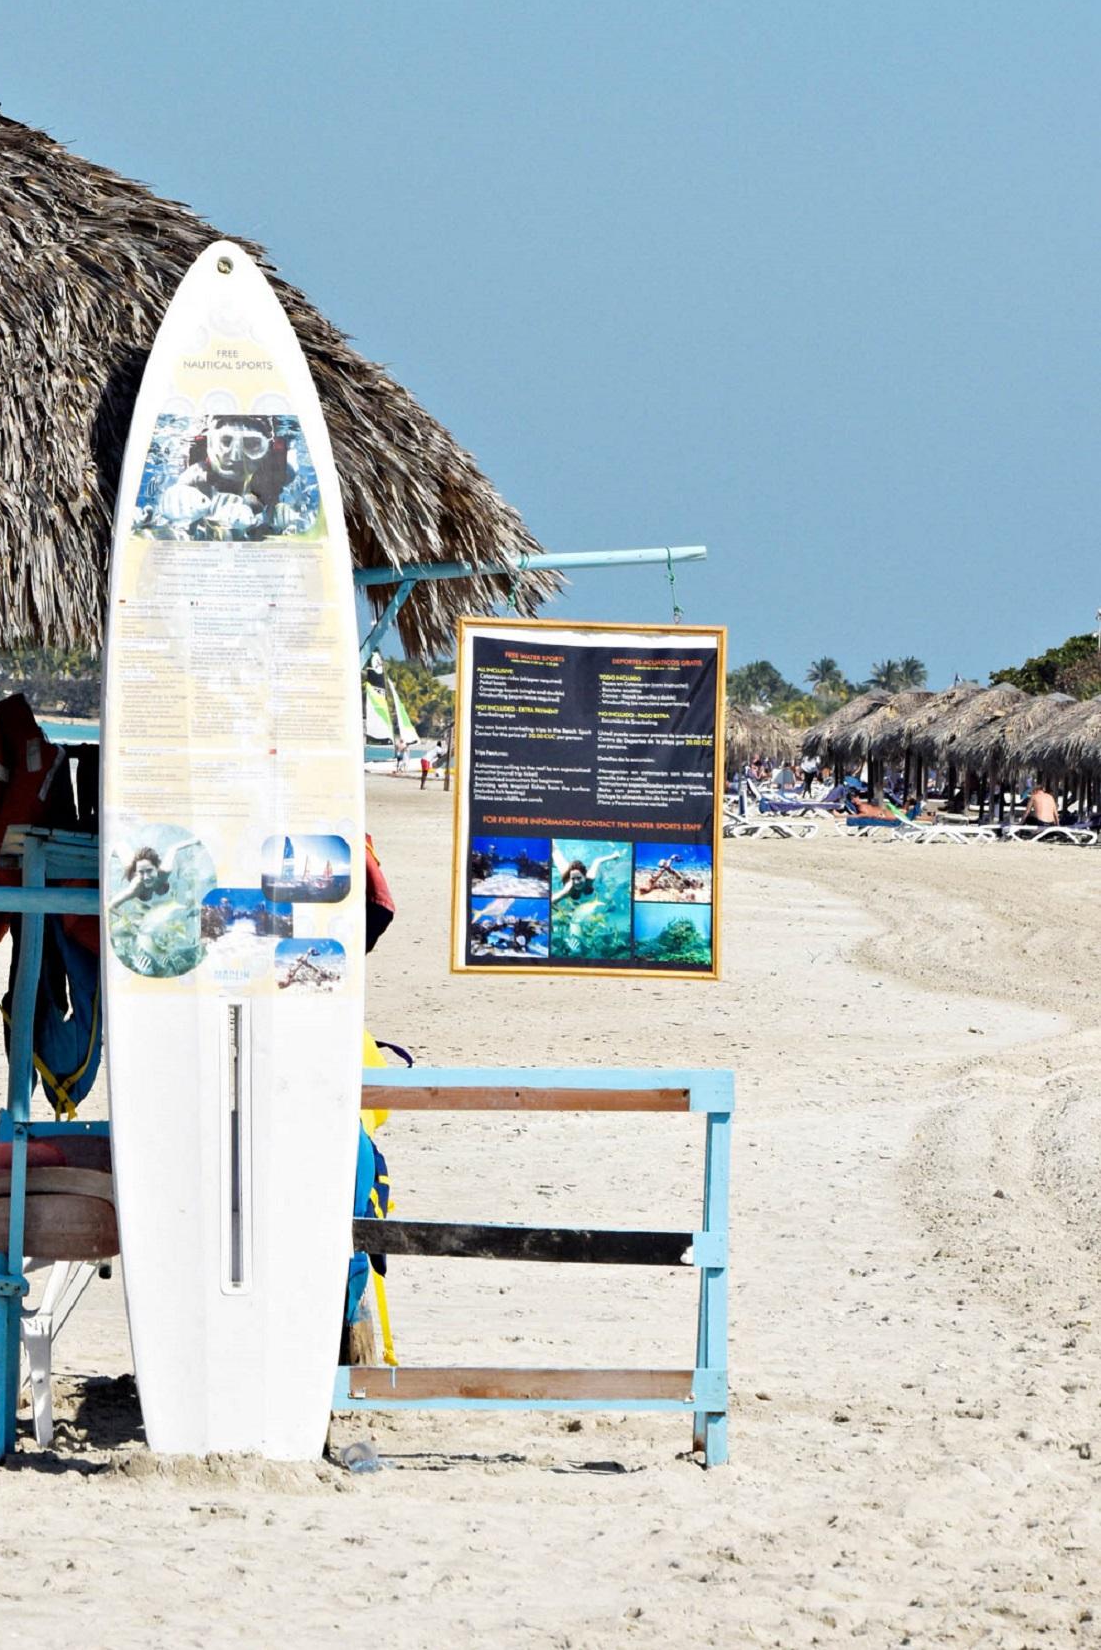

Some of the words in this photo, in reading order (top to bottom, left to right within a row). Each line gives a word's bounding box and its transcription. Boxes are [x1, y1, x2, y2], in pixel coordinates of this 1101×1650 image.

[217, 350, 239, 358] FREE
[184, 361, 233, 369] NAUTICAL
[235, 361, 273, 370] SPORTS
[505, 651, 519, 659] FREE
[483, 816, 496, 824] FOR
[499, 816, 529, 825] FURTHER
[530, 818, 580, 827] INFORMATION
[582, 820, 615, 828] CONTACT
[656, 822, 681, 830] SPORTS
